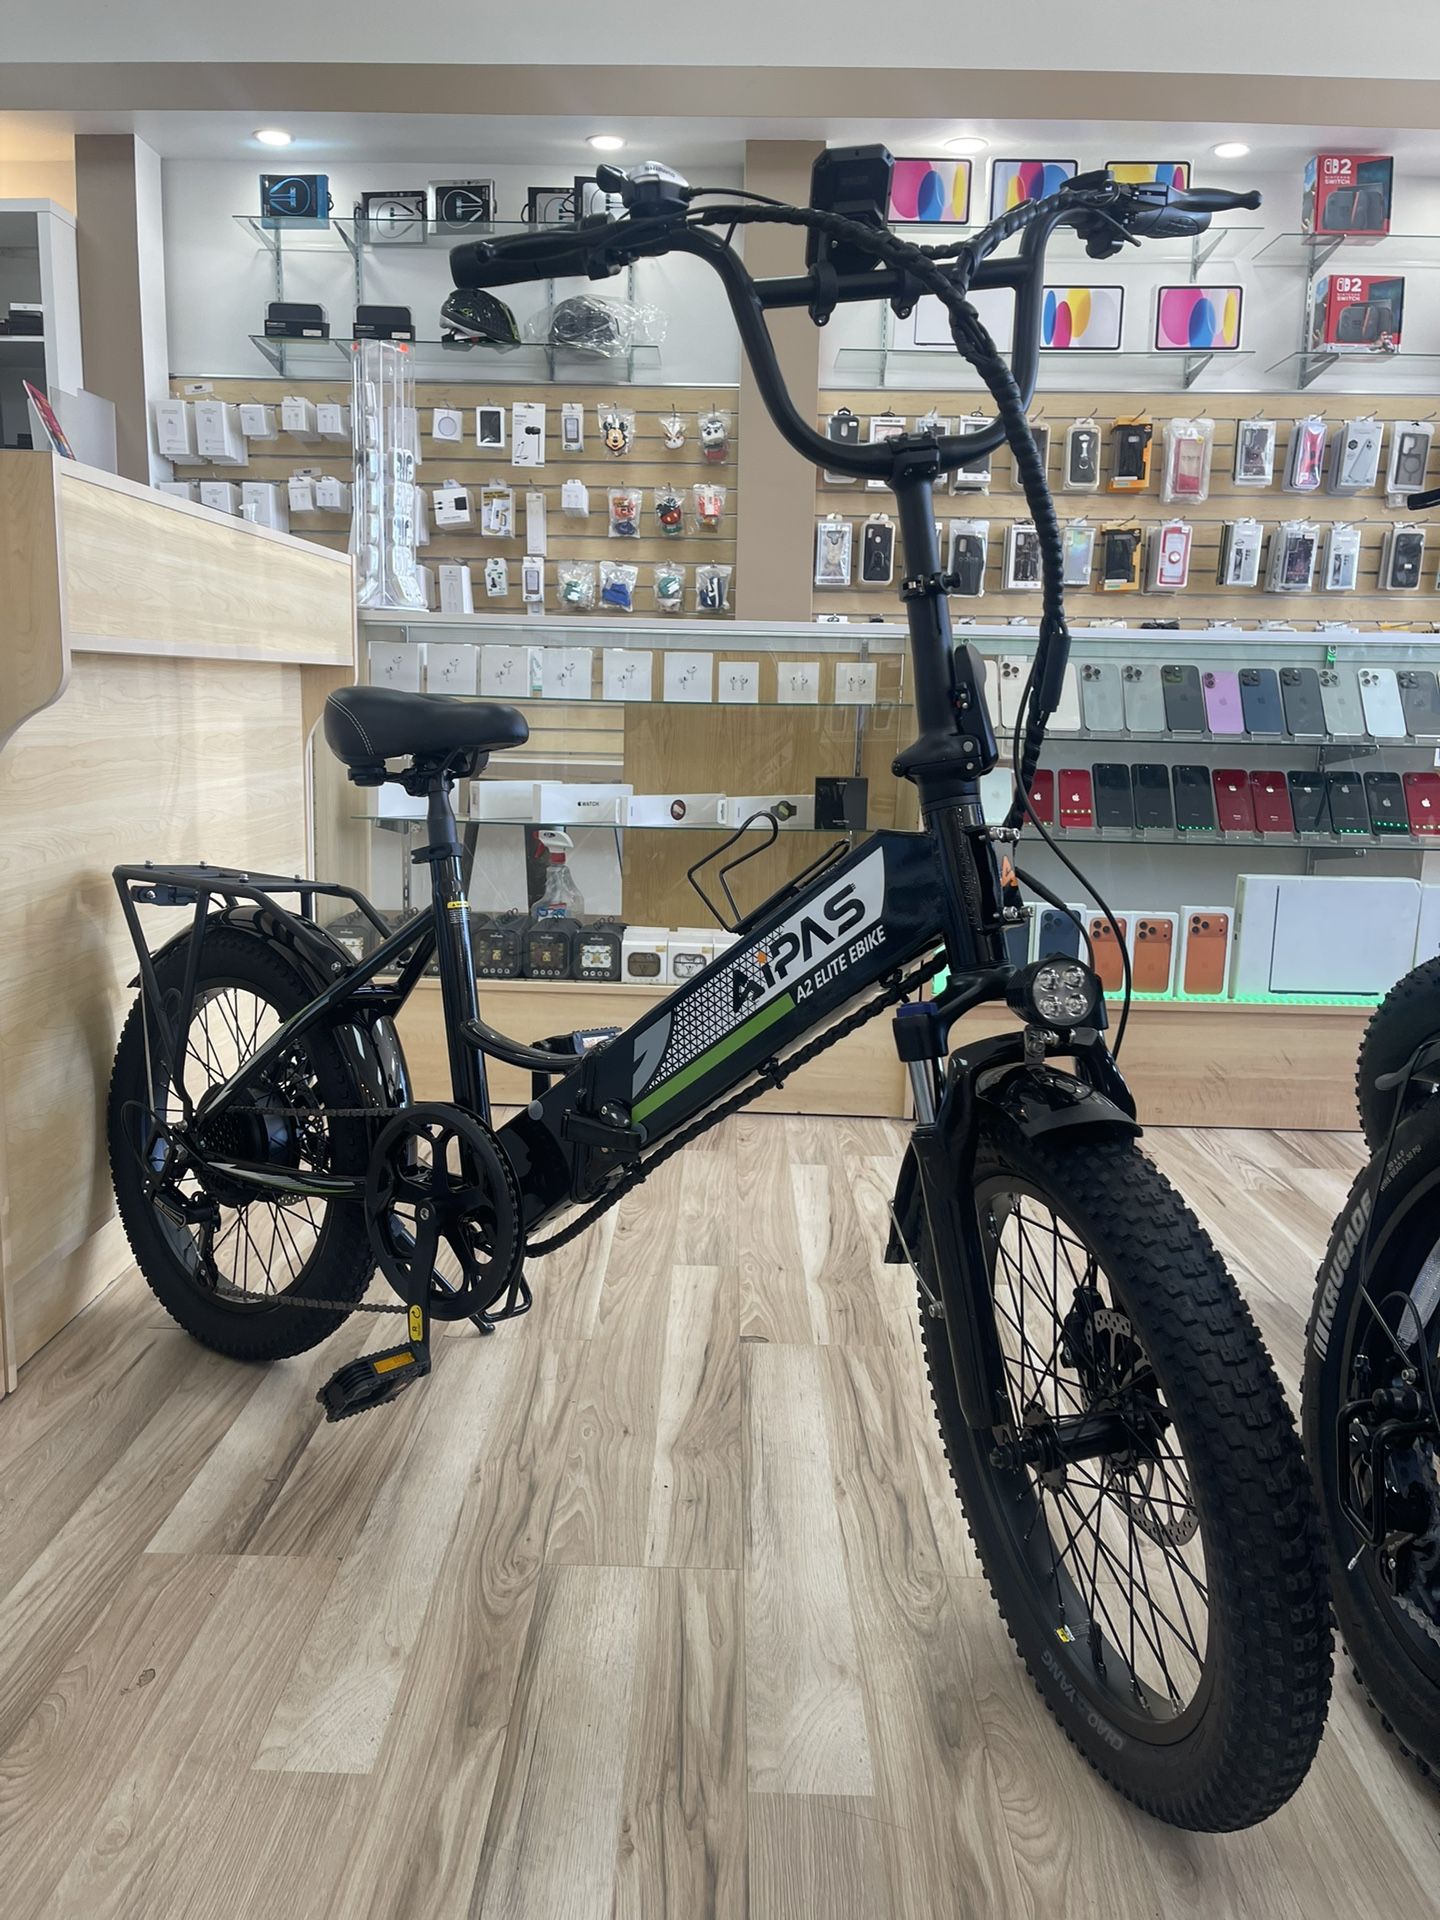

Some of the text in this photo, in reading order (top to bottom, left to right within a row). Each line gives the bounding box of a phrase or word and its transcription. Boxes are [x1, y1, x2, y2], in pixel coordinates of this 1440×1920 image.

[1340, 159, 1352, 174] 2
[1351, 278, 1362, 292] 2
[796, 924, 886, 1003] A2 ELITE EBIKE
[1318, 1188, 1373, 1330] KRUSADE
[1040, 1650, 1079, 1703] YANG
